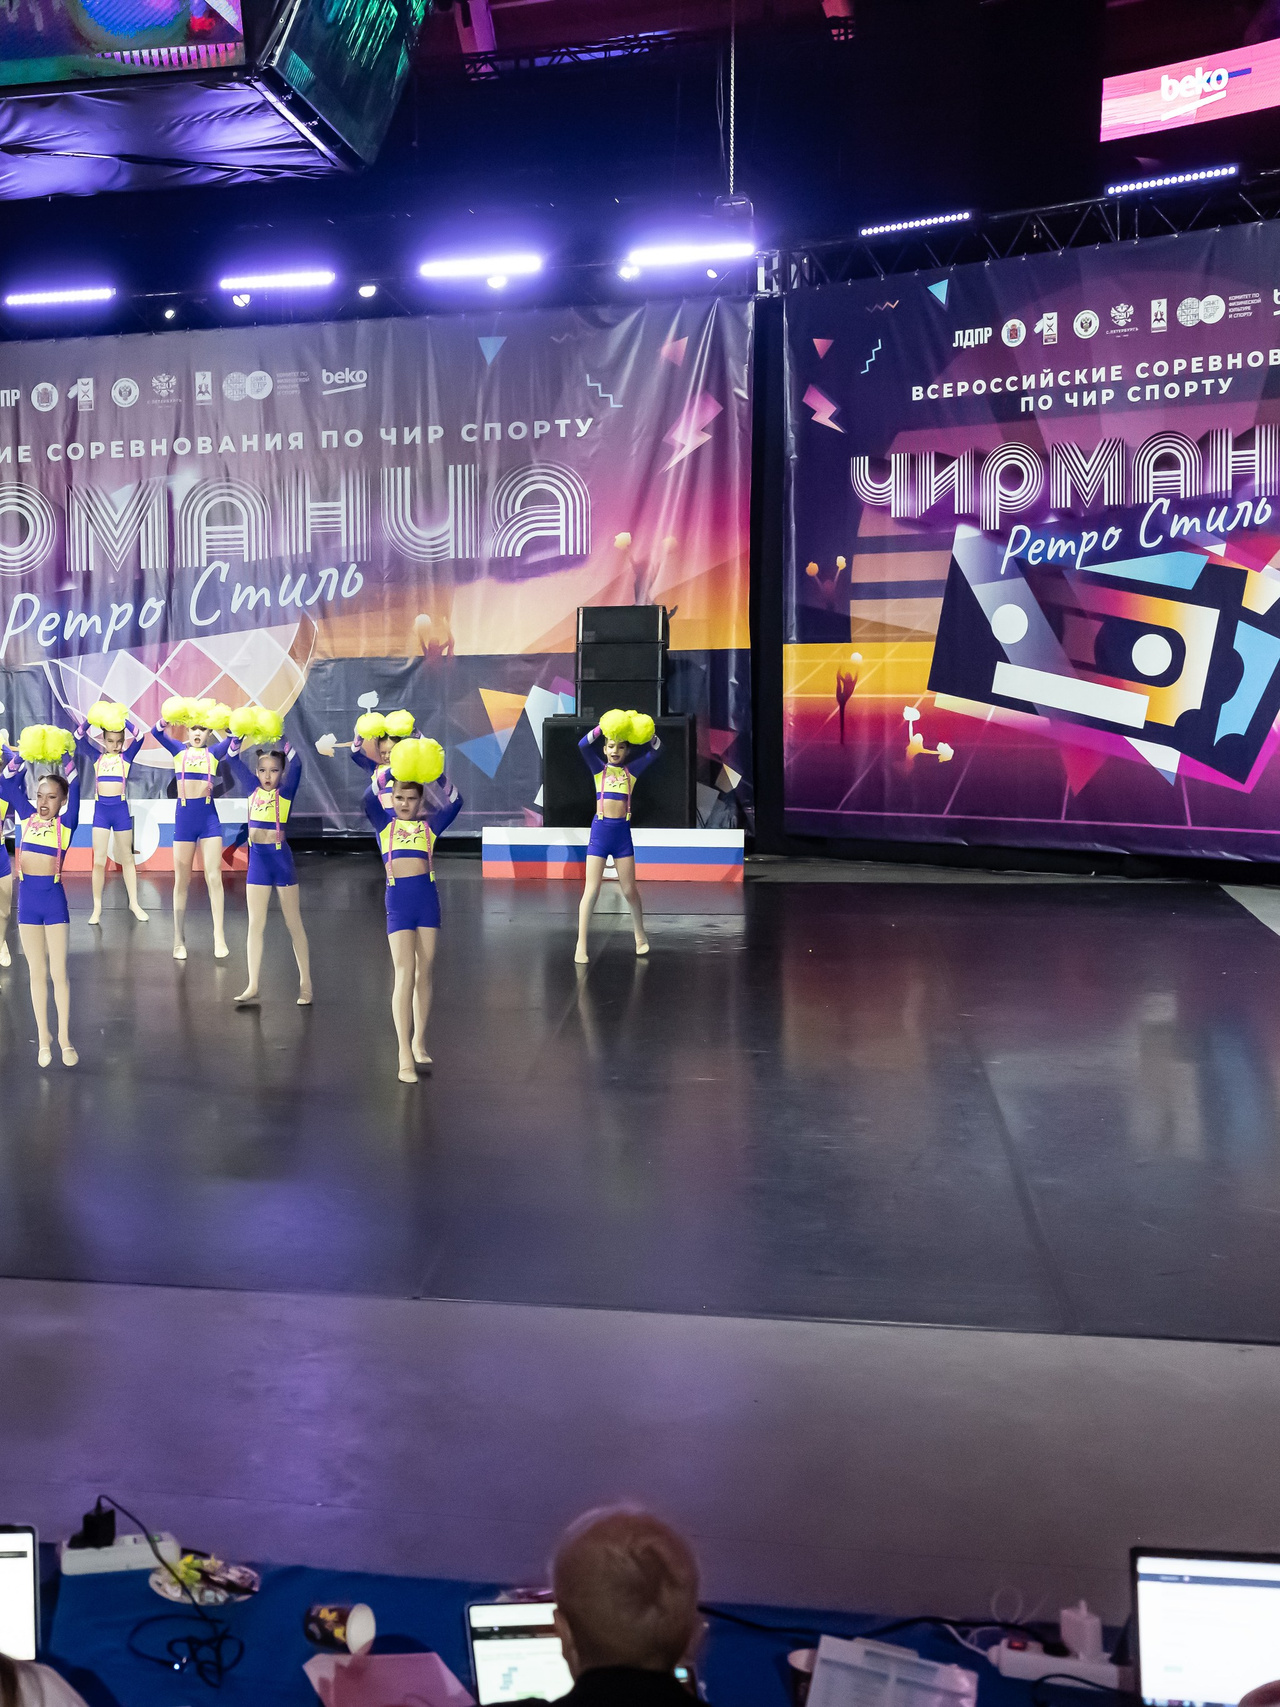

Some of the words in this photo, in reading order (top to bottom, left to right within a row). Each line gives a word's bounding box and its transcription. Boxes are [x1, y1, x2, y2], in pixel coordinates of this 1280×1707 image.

[1160, 67, 1229, 101] beko
[953, 327, 993, 348] ЛДПР
[321, 367, 368, 385] beko
[911, 365, 1123, 401] ВСЕРОССИЙСКИЕ
[1021, 395, 1053, 412] ПО
[1065, 388, 1115, 408] ЧИР
[1127, 376, 1233, 402] СПОРТУ
[46, 431, 304, 463] СОРЕВНОВАНИЯ
[321, 428, 364, 448] ПО
[380, 424, 445, 446] ЧИР
[461, 418, 593, 443] СПОРТУ
[1001, 525, 1122, 575] Ретро
[1139, 496, 1272, 548] Стиль
[0, 592, 165, 660] Ретро
[189, 561, 364, 627] Стиль
